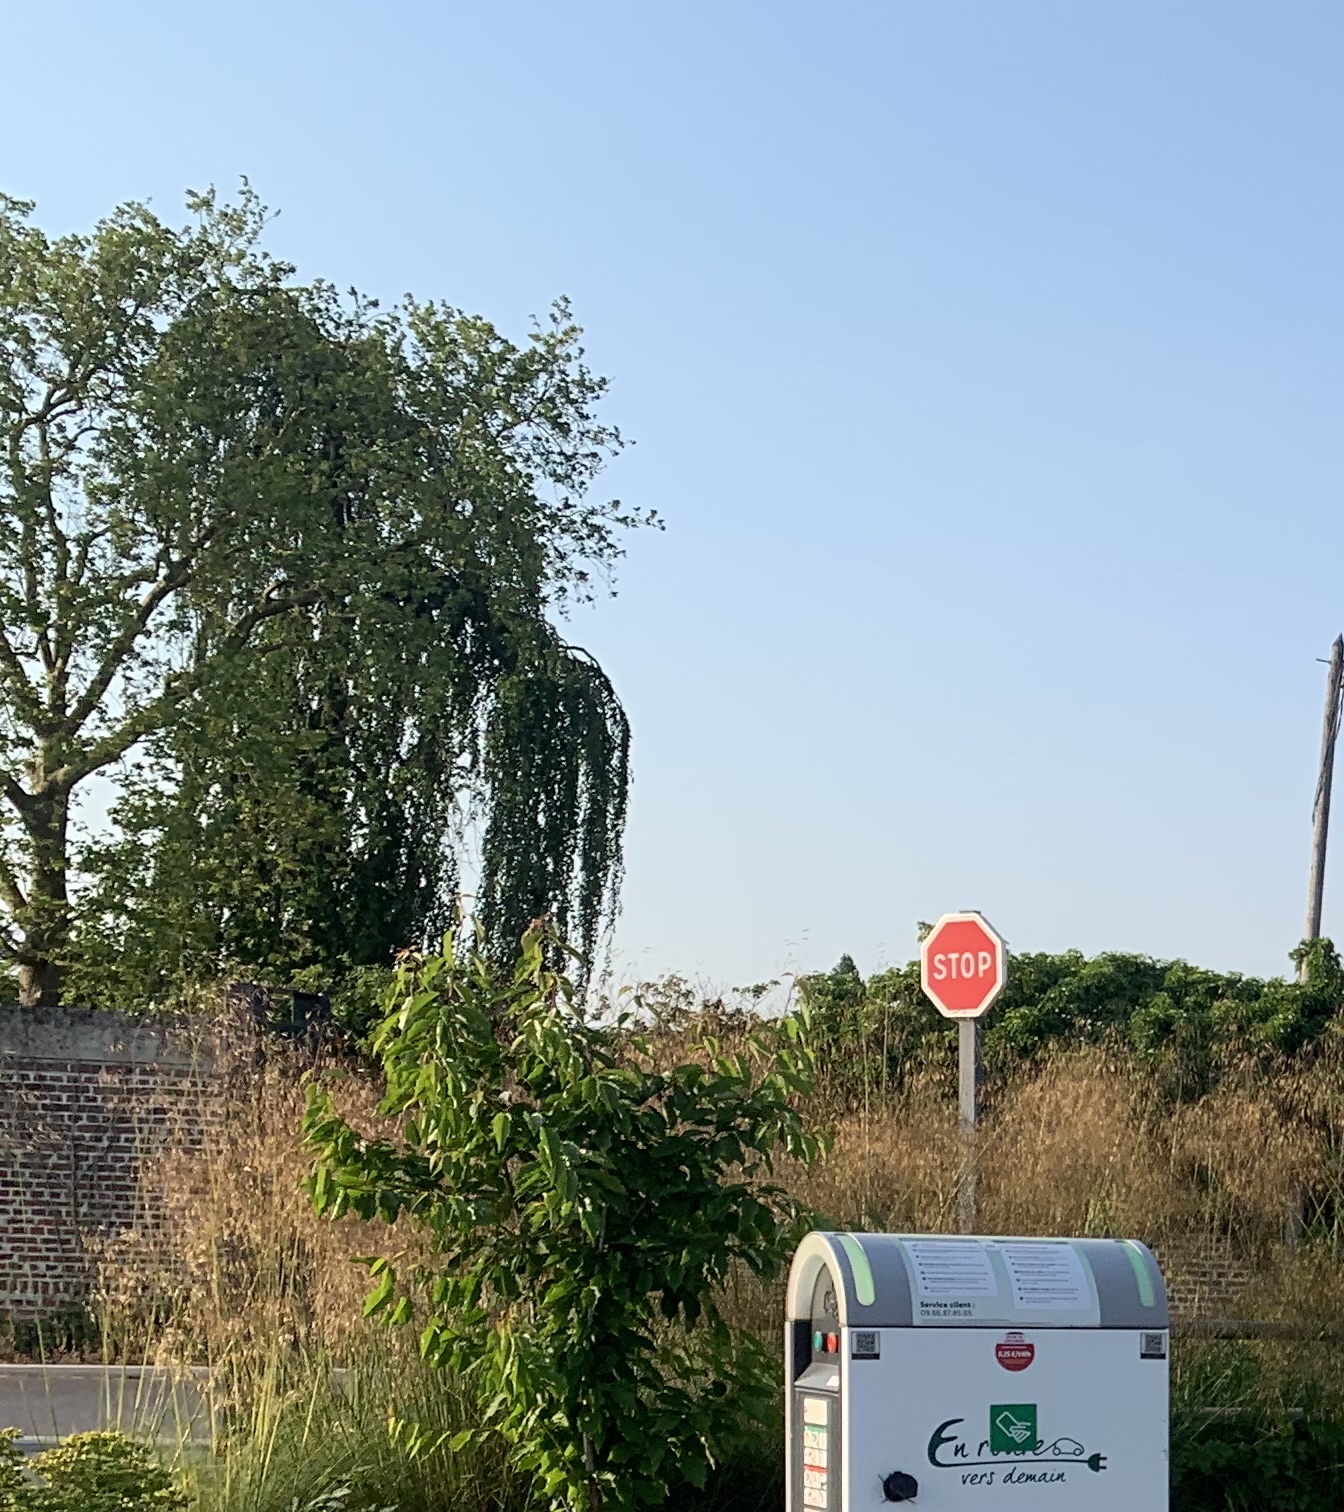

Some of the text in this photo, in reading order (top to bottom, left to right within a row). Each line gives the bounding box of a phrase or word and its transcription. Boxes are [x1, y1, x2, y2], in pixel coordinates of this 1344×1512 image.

[933, 951, 992, 980] STOP
[928, 1418, 968, 1467] En
[961, 1466, 1066, 1485] vers demain
